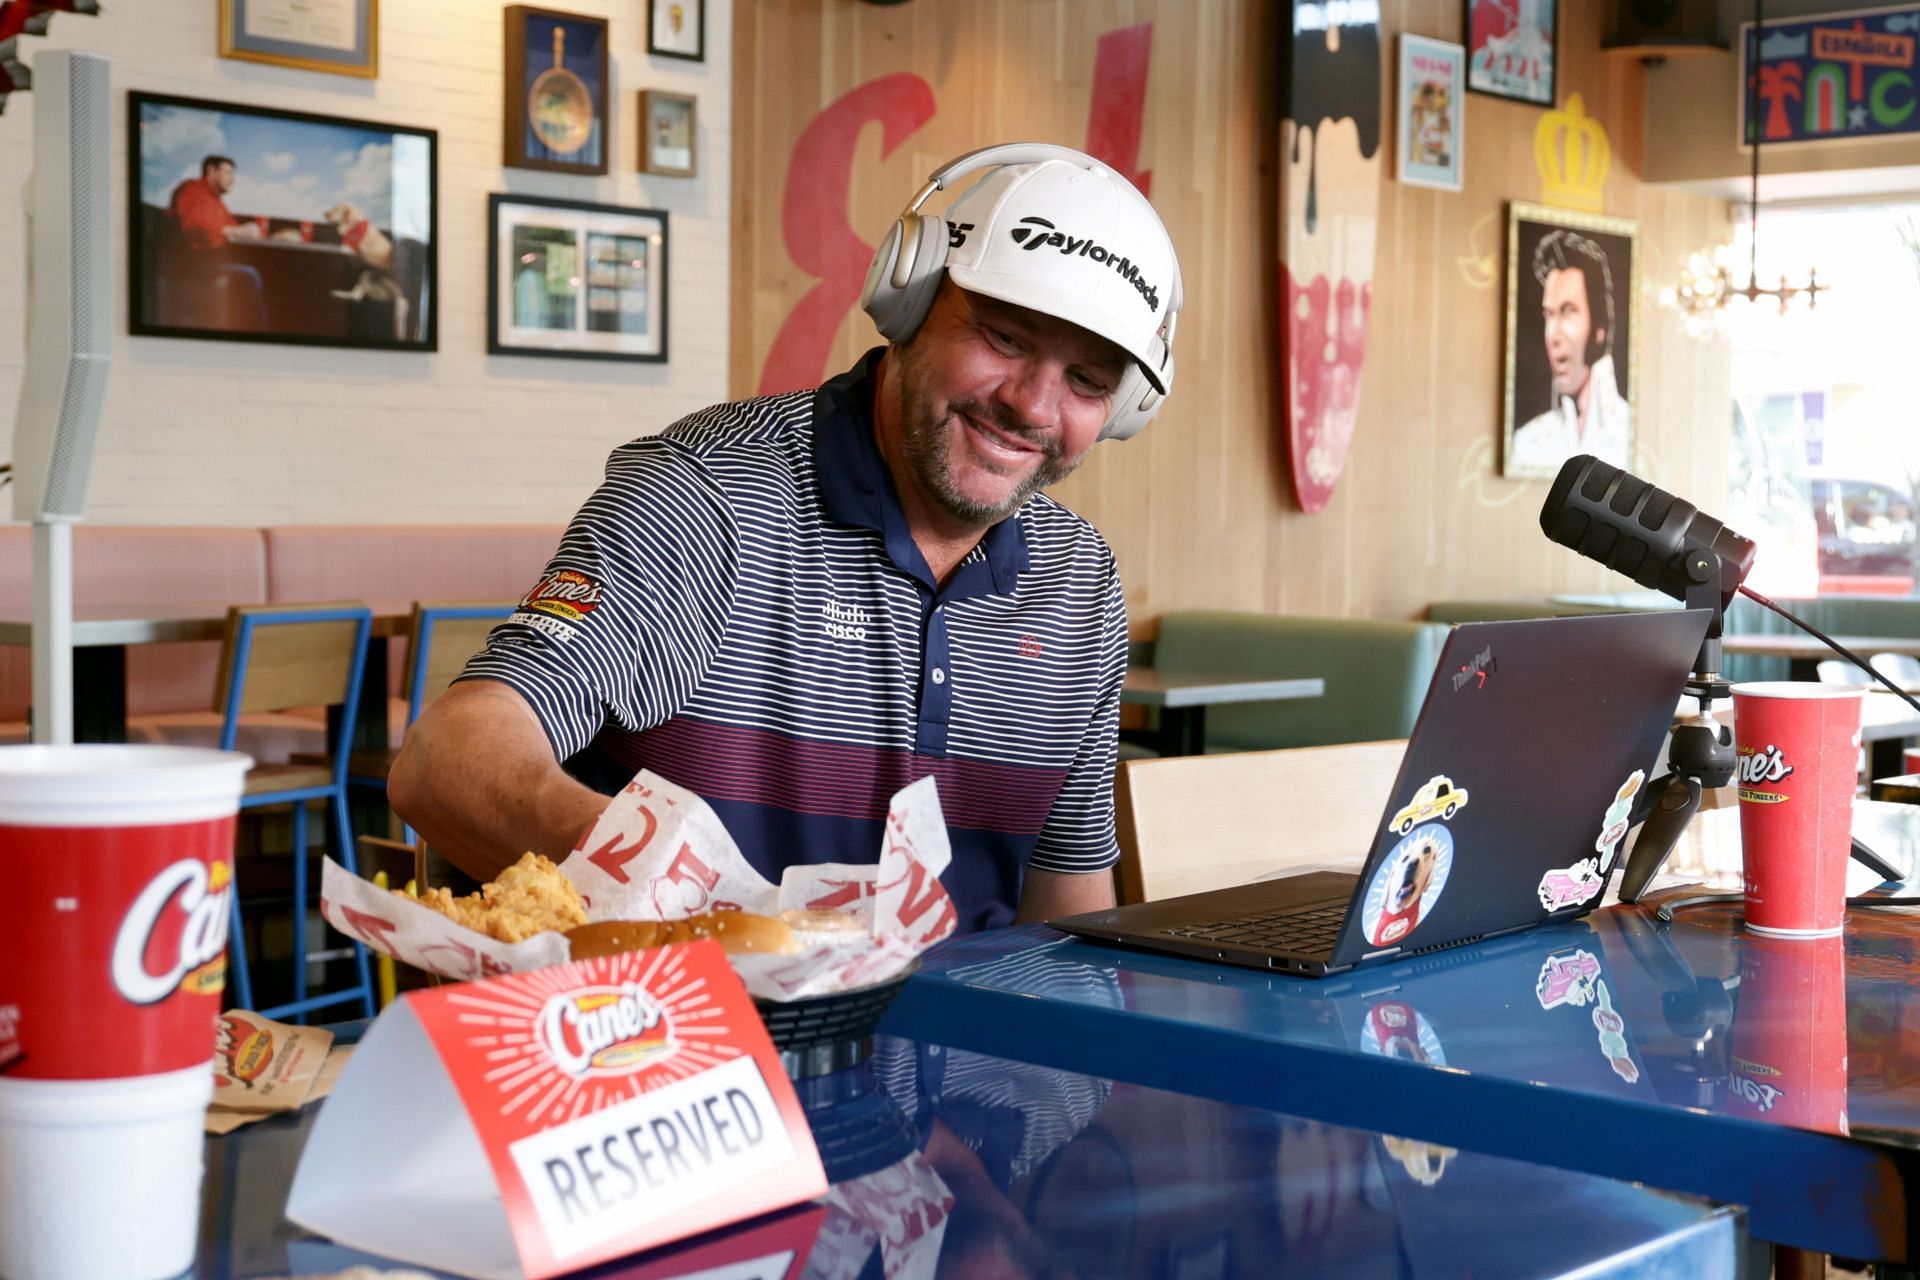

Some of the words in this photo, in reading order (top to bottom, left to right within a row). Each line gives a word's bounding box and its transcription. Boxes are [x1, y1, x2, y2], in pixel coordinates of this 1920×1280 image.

[1011, 217, 1160, 312] TaylorMade
[825, 622, 866, 640] cisco
[1736, 744, 1793, 783] ne's
[546, 980, 664, 1073] Cane's
[544, 1088, 764, 1224] RESERVED
